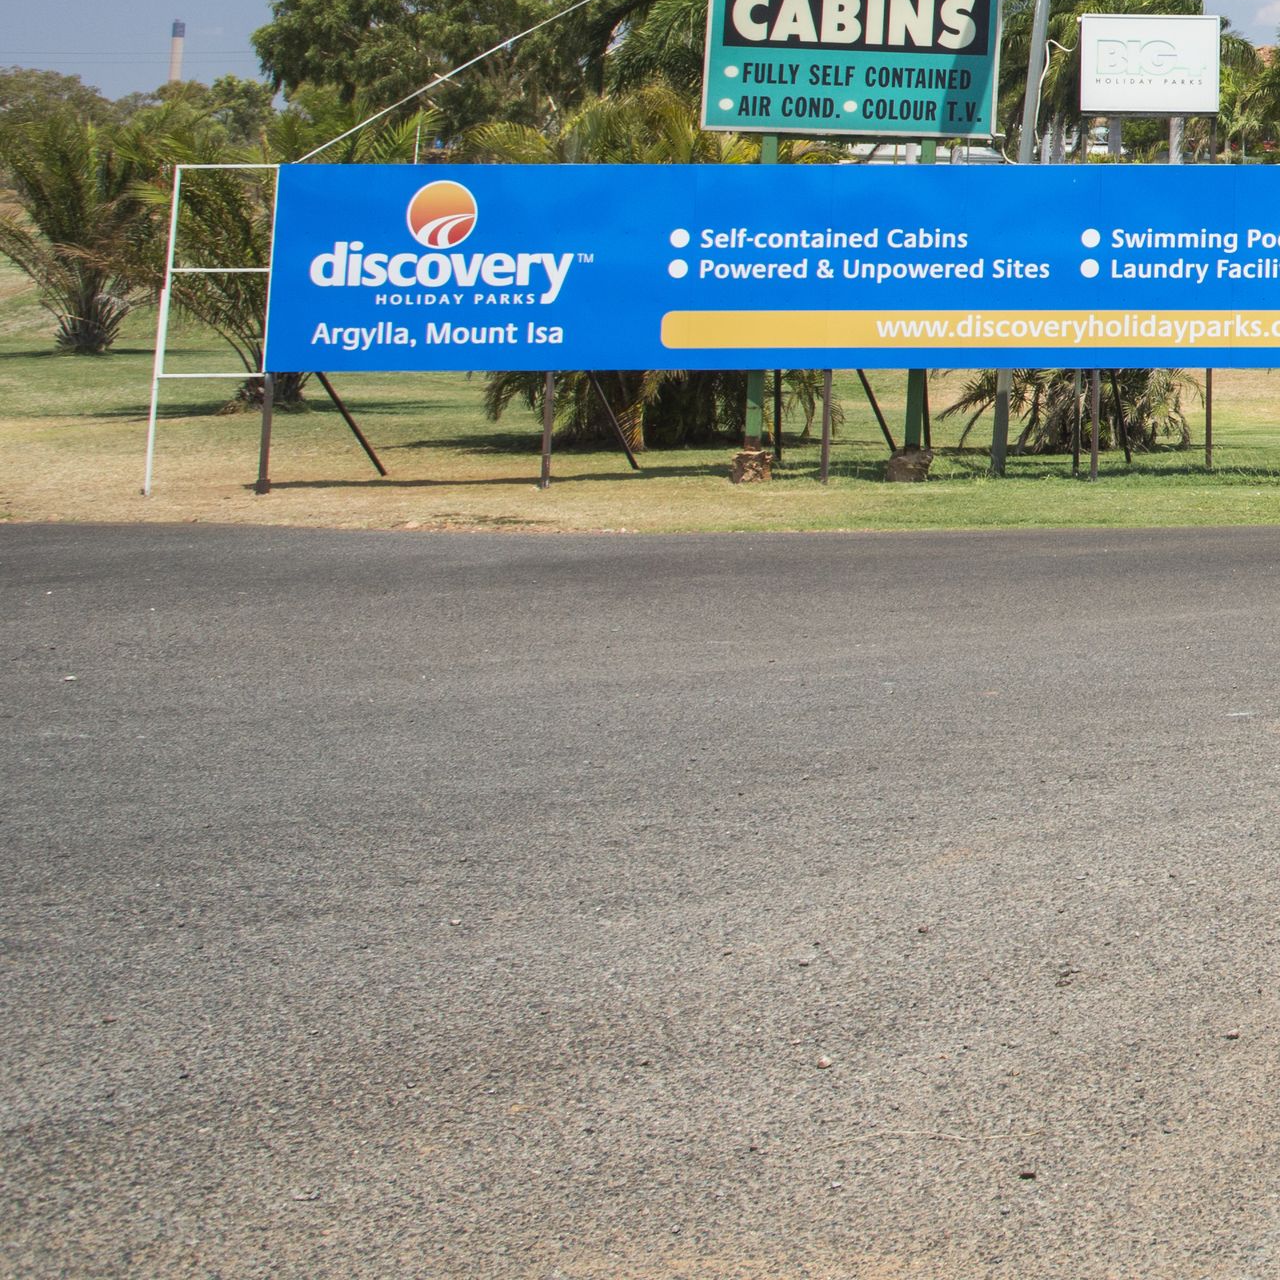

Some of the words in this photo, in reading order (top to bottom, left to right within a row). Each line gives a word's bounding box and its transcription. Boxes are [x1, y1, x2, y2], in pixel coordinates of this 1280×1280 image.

[742, 62, 800, 85] FULLY
[809, 64, 855, 87] SELF
[865, 66, 971, 90] CONTAINED
[738, 95, 771, 117] AIR
[781, 96, 840, 119] COND.
[862, 99, 937, 121] COLOUR
[947, 101, 982, 123] T.V.
[700, 228, 879, 249] Self-contained
[887, 228, 968, 249] Cabins
[1111, 228, 1238, 254] Swimming
[309, 241, 574, 305] discovery
[699, 258, 807, 279] Powered
[816, 259, 834, 279] &
[843, 258, 984, 284] Unpowered
[992, 258, 1050, 279] Sites
[1110, 258, 1208, 284] Laundry
[375, 293, 464, 305] HOLIDAY
[474, 293, 535, 305] PARKS
[311, 322, 416, 351] Argylla,
[426, 322, 518, 344] Mount
[527, 322, 564, 344] Isa
